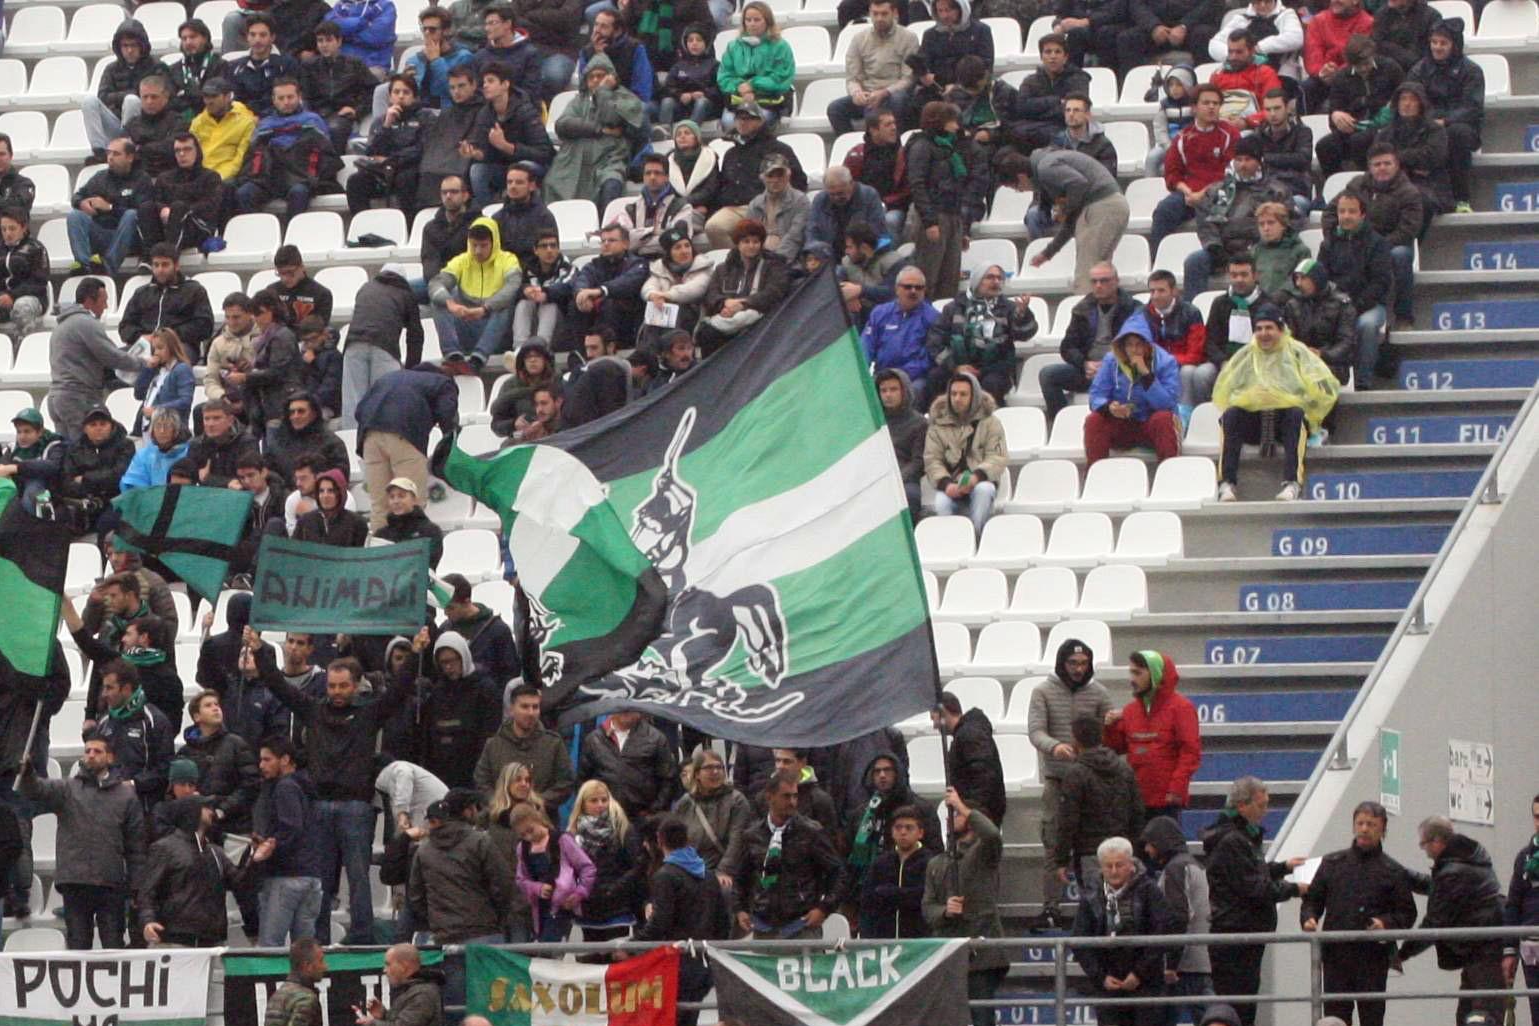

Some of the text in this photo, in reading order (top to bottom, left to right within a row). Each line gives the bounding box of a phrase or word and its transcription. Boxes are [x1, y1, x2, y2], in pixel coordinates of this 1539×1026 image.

[1500, 194, 1513, 212] G
[1470, 252, 1517, 271] G 14
[1438, 312, 1485, 330] G 13
[1405, 372, 1453, 390] G 12
[1373, 423, 1510, 444] G 11 FILA
[1312, 482, 1360, 501] G 10
[1278, 537, 1328, 555] G 09
[1245, 592, 1295, 611] G 08
[1211, 646, 1261, 664] G 07
[1198, 704, 1225, 722] 06
[776, 944, 903, 993] BLACK
